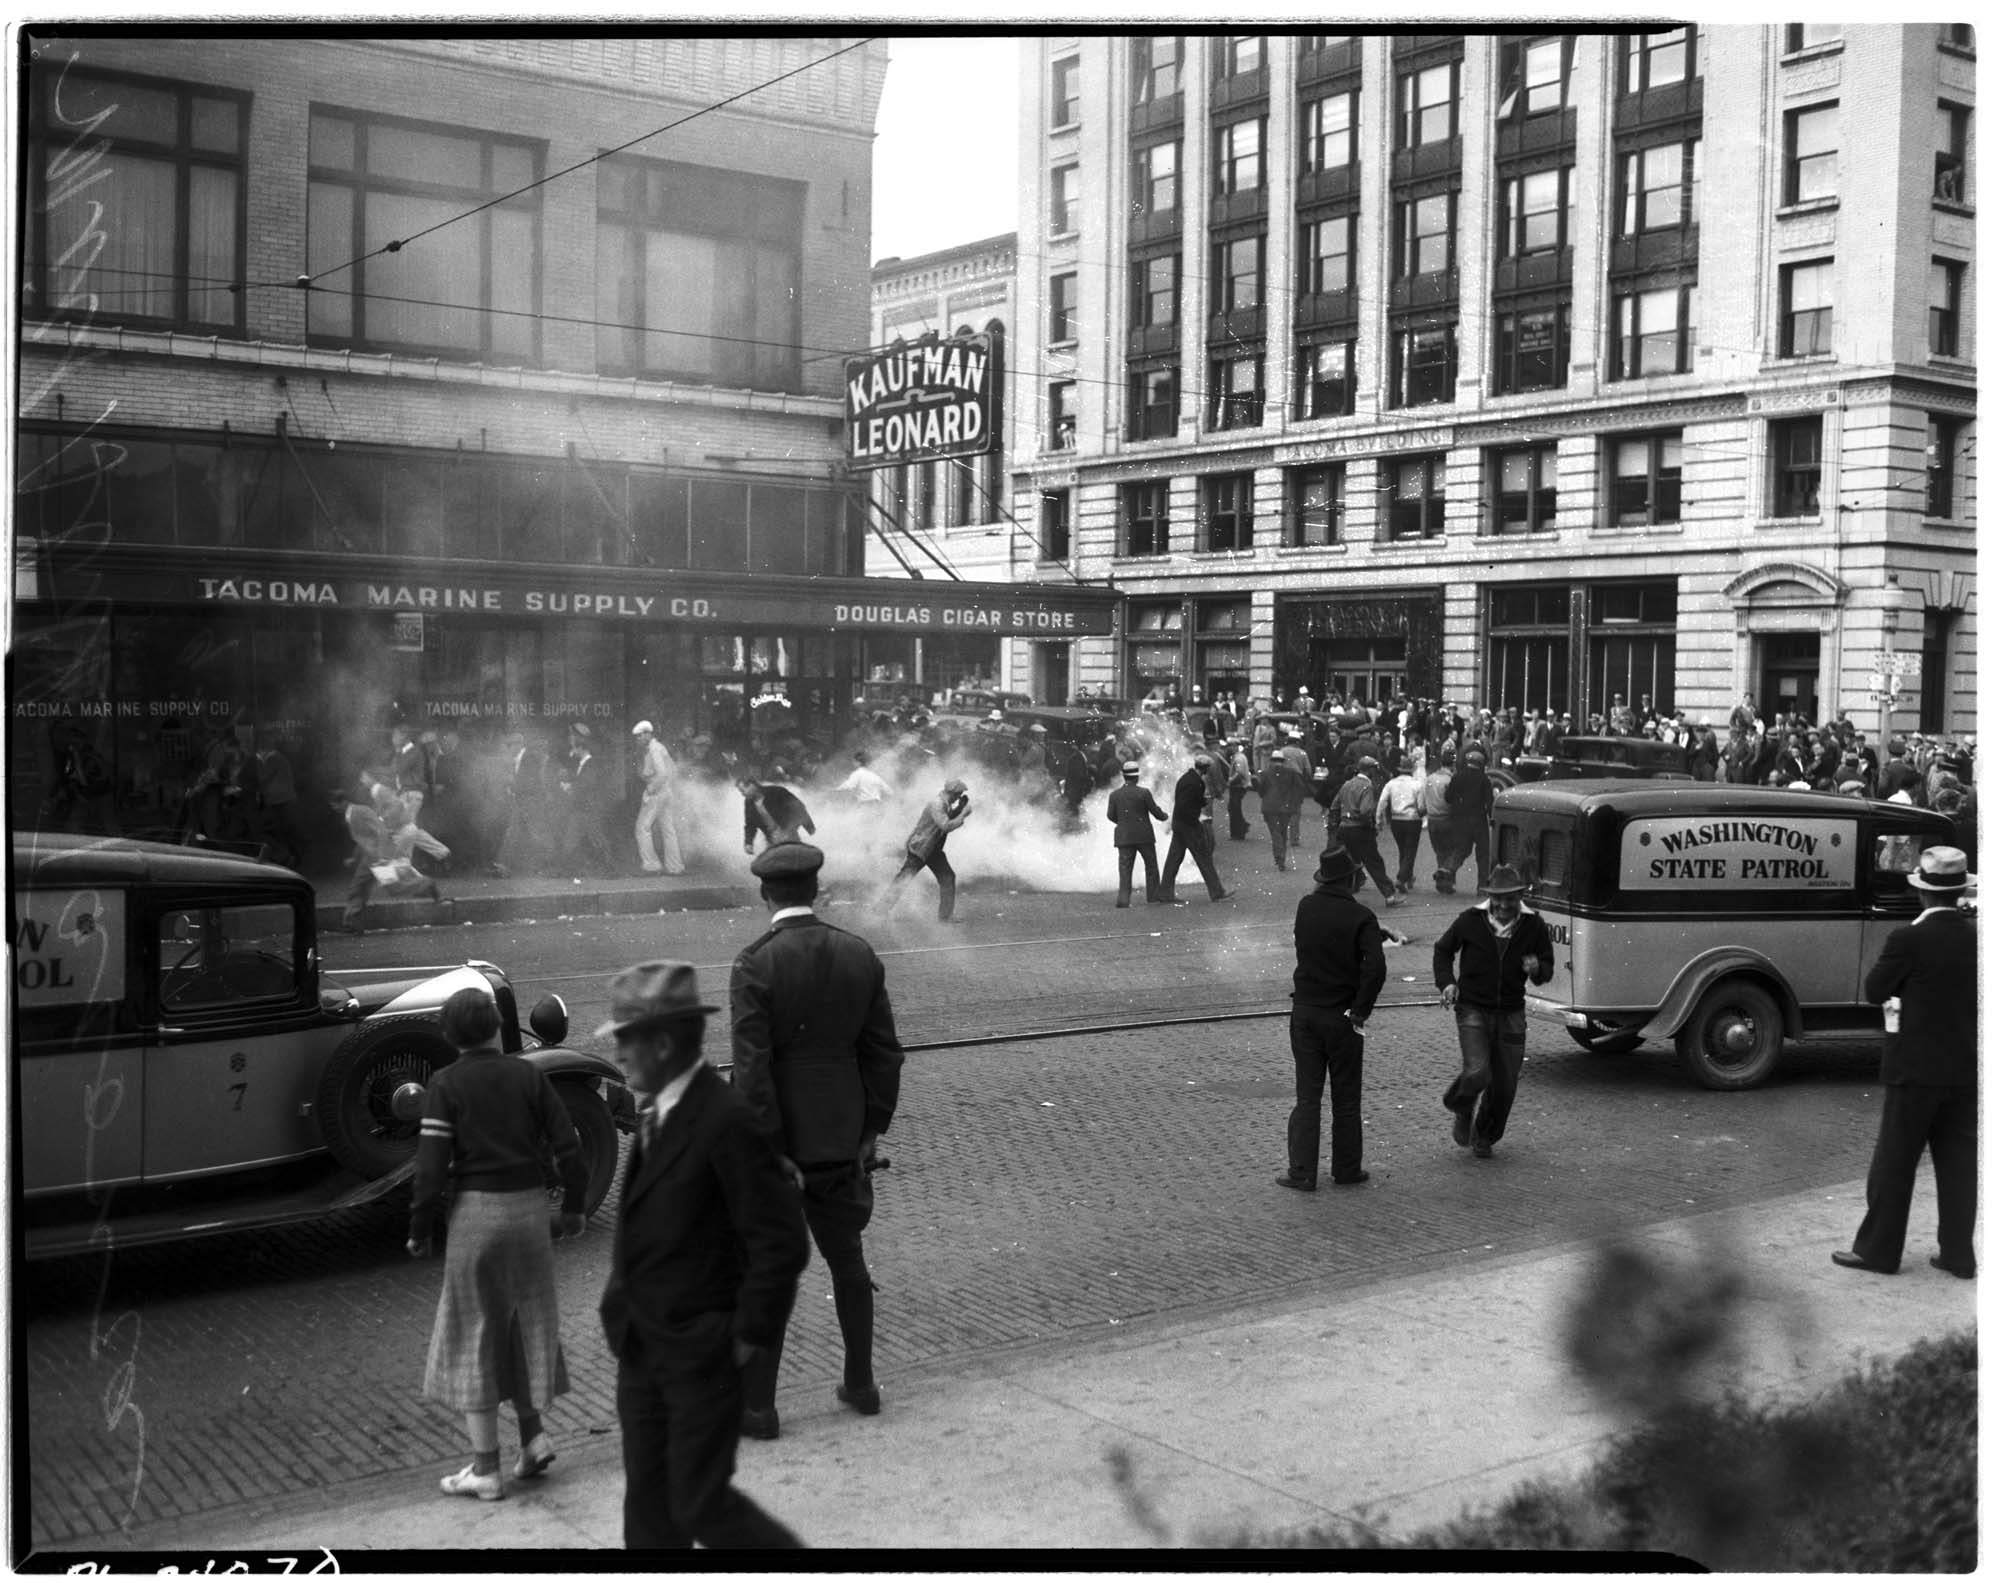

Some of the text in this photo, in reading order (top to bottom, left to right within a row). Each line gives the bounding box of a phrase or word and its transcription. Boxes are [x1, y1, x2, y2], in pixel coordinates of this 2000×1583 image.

[849, 346, 987, 415] KAUFMAN
[853, 401, 982, 457] LEONARD
[199, 577, 718, 618] TACOMA MARINE SUPPLY CO.
[836, 605, 1075, 628] DOUGLAS CIGAR STORE
[15, 702, 73, 717] ACOMA
[80, 701, 141, 717] MARINE
[149, 701, 202, 716] SUPPLY
[425, 702, 480, 717] TACOMA
[485, 703, 536, 717] MARINE
[543, 703, 589, 717] SUPPLY
[1660, 822, 1818, 856] WASHINGTON
[1649, 859, 1829, 879] STATE PATROL
[226, 1082, 248, 1112] 7
